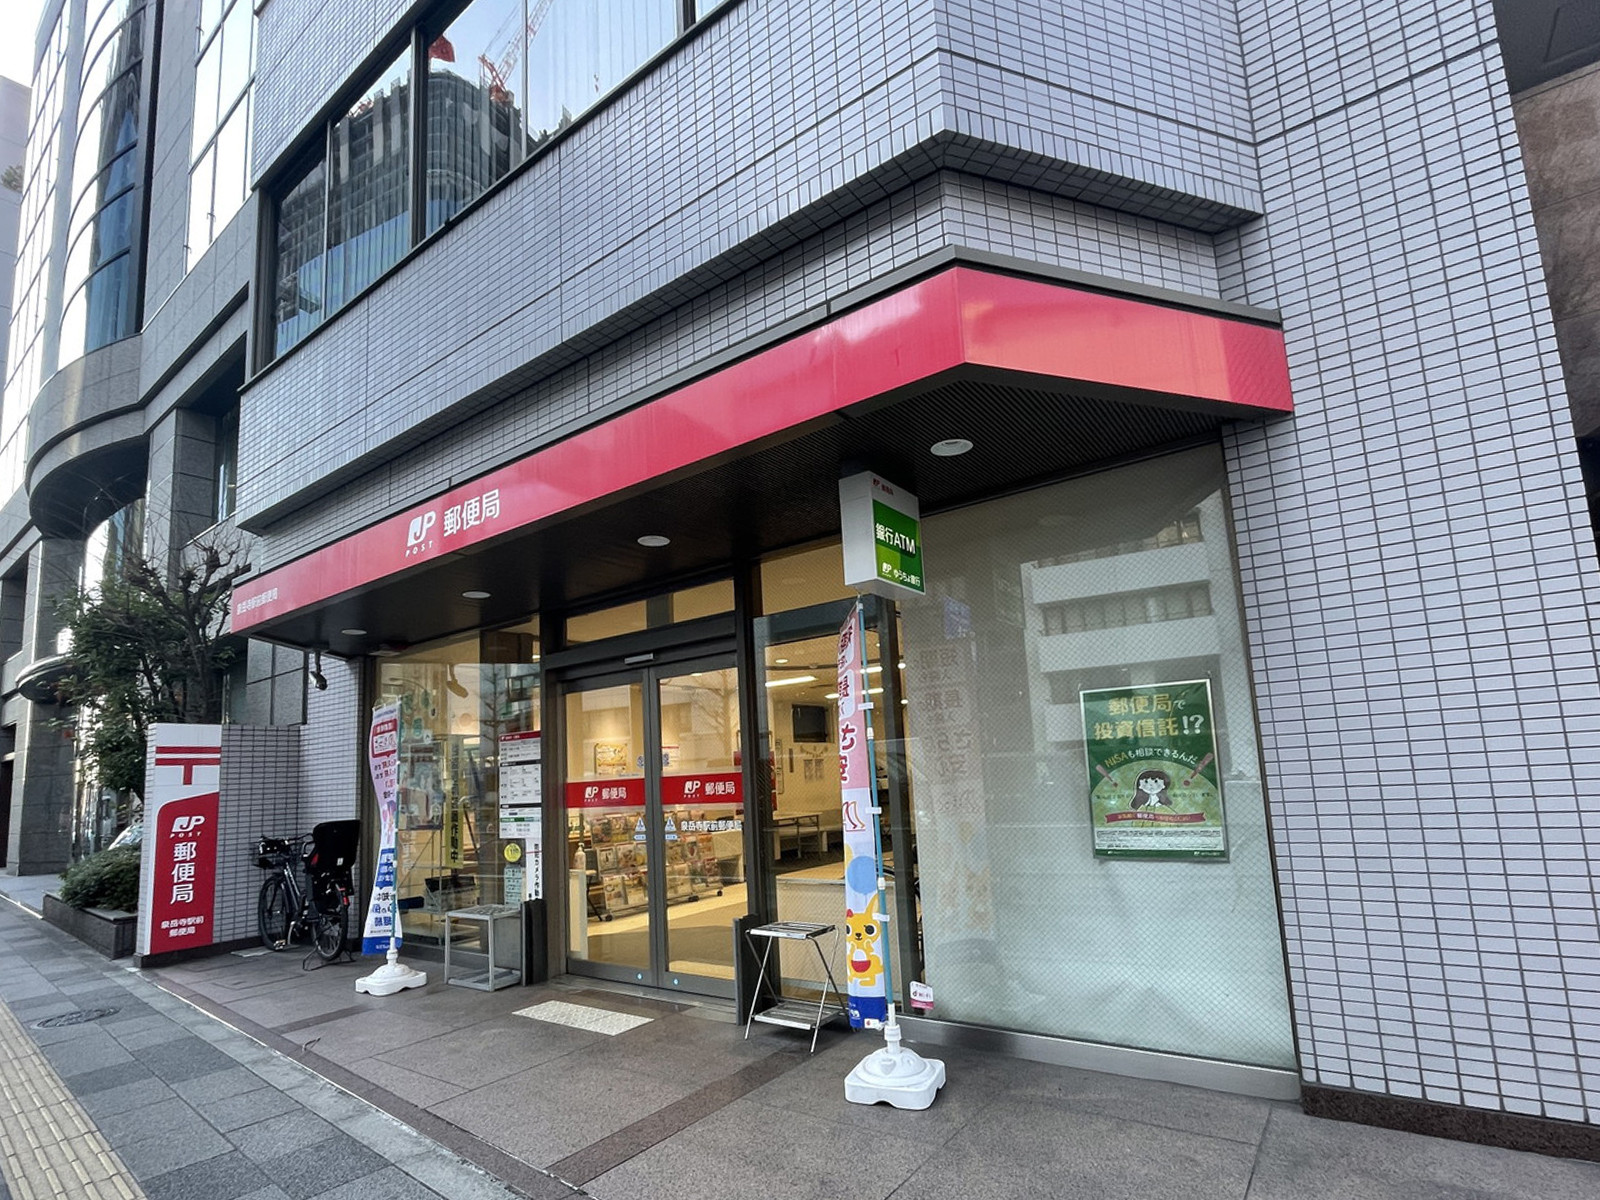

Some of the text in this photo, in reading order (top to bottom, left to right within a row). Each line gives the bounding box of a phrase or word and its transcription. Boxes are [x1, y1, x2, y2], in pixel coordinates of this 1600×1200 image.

[443, 487, 501, 537] 郵便局
[876, 523, 916, 554] 銀行ATM
[405, 541, 433, 558] POST
[894, 569, 920, 587] ゆうちょ銀行
[1108, 694, 1186, 715] 郵便局で
[601, 787, 627, 800] 郵便局
[704, 781, 736, 796] 郵便局
[681, 820, 743, 831] 泉岳寺駅前郵便局
[170, 842, 197, 904] 郵便局
[161, 916, 204, 929] 泉岳寺駅前
[169, 927, 195, 937] 郵便局
